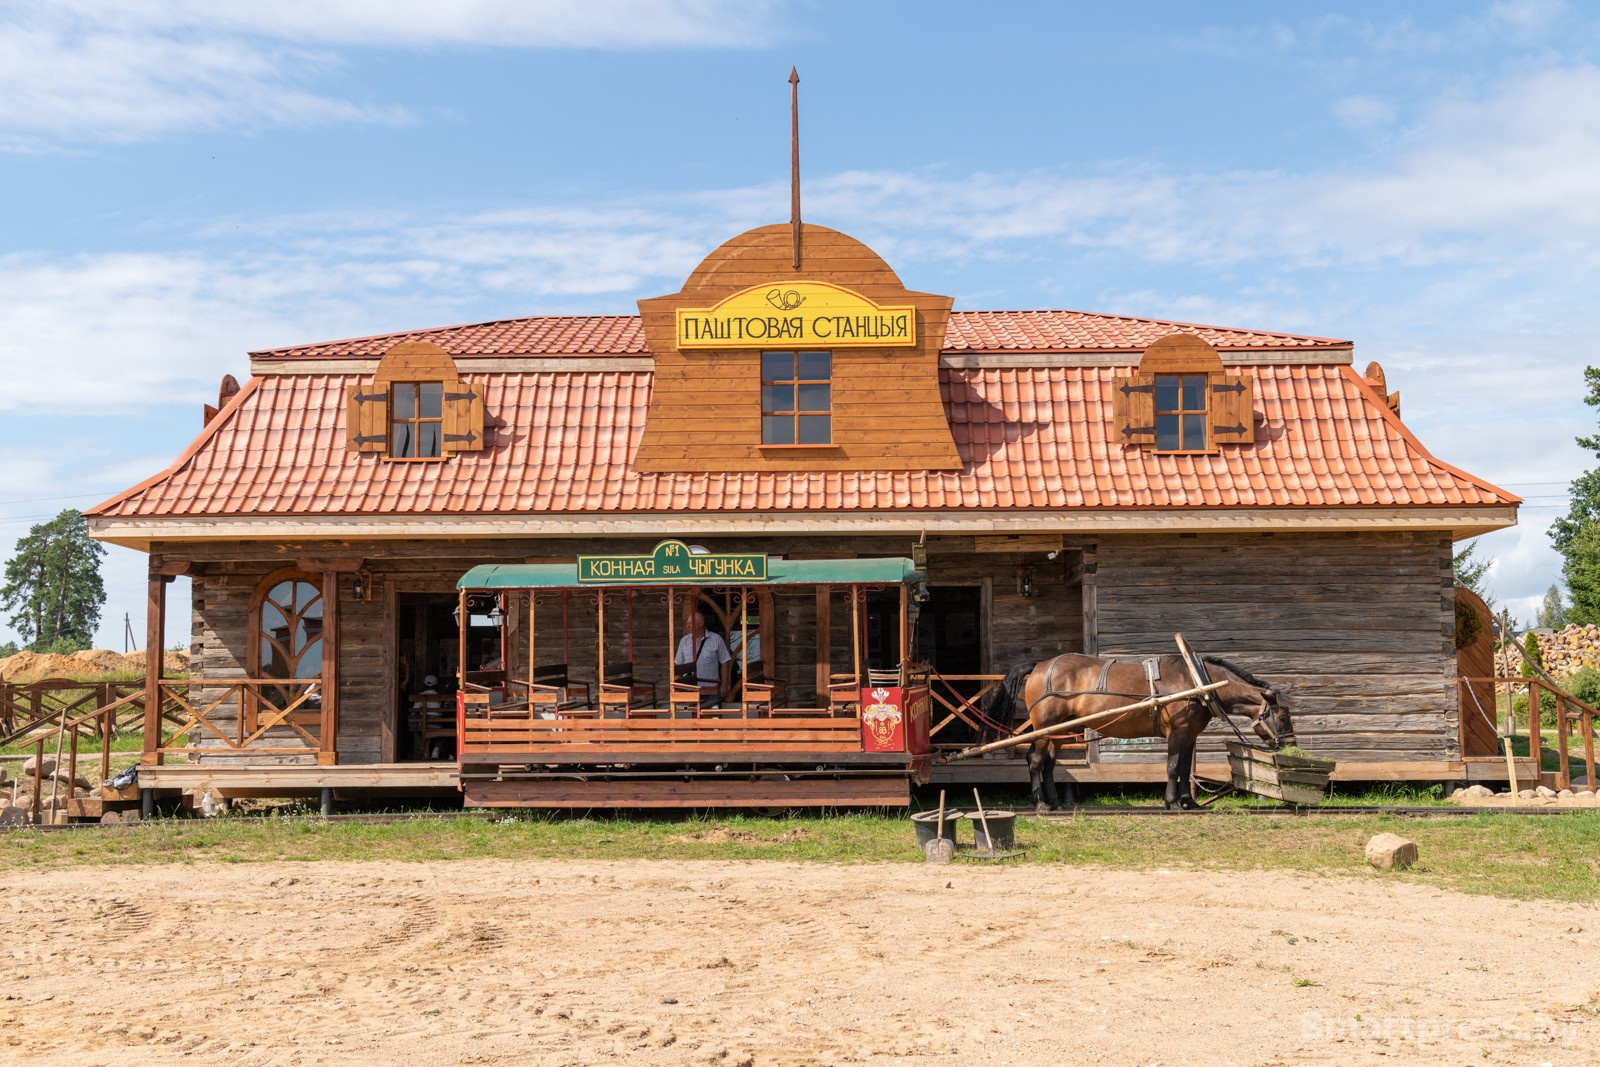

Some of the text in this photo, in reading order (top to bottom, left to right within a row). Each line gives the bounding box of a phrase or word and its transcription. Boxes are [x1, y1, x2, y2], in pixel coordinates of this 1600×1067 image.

[684, 315, 908, 340] ПАШТОВАЯ СТАНЦЫЯ
[590, 558, 756, 576] КОННАЯ ЧЫГУНКА
[662, 565, 681, 575] SULA
